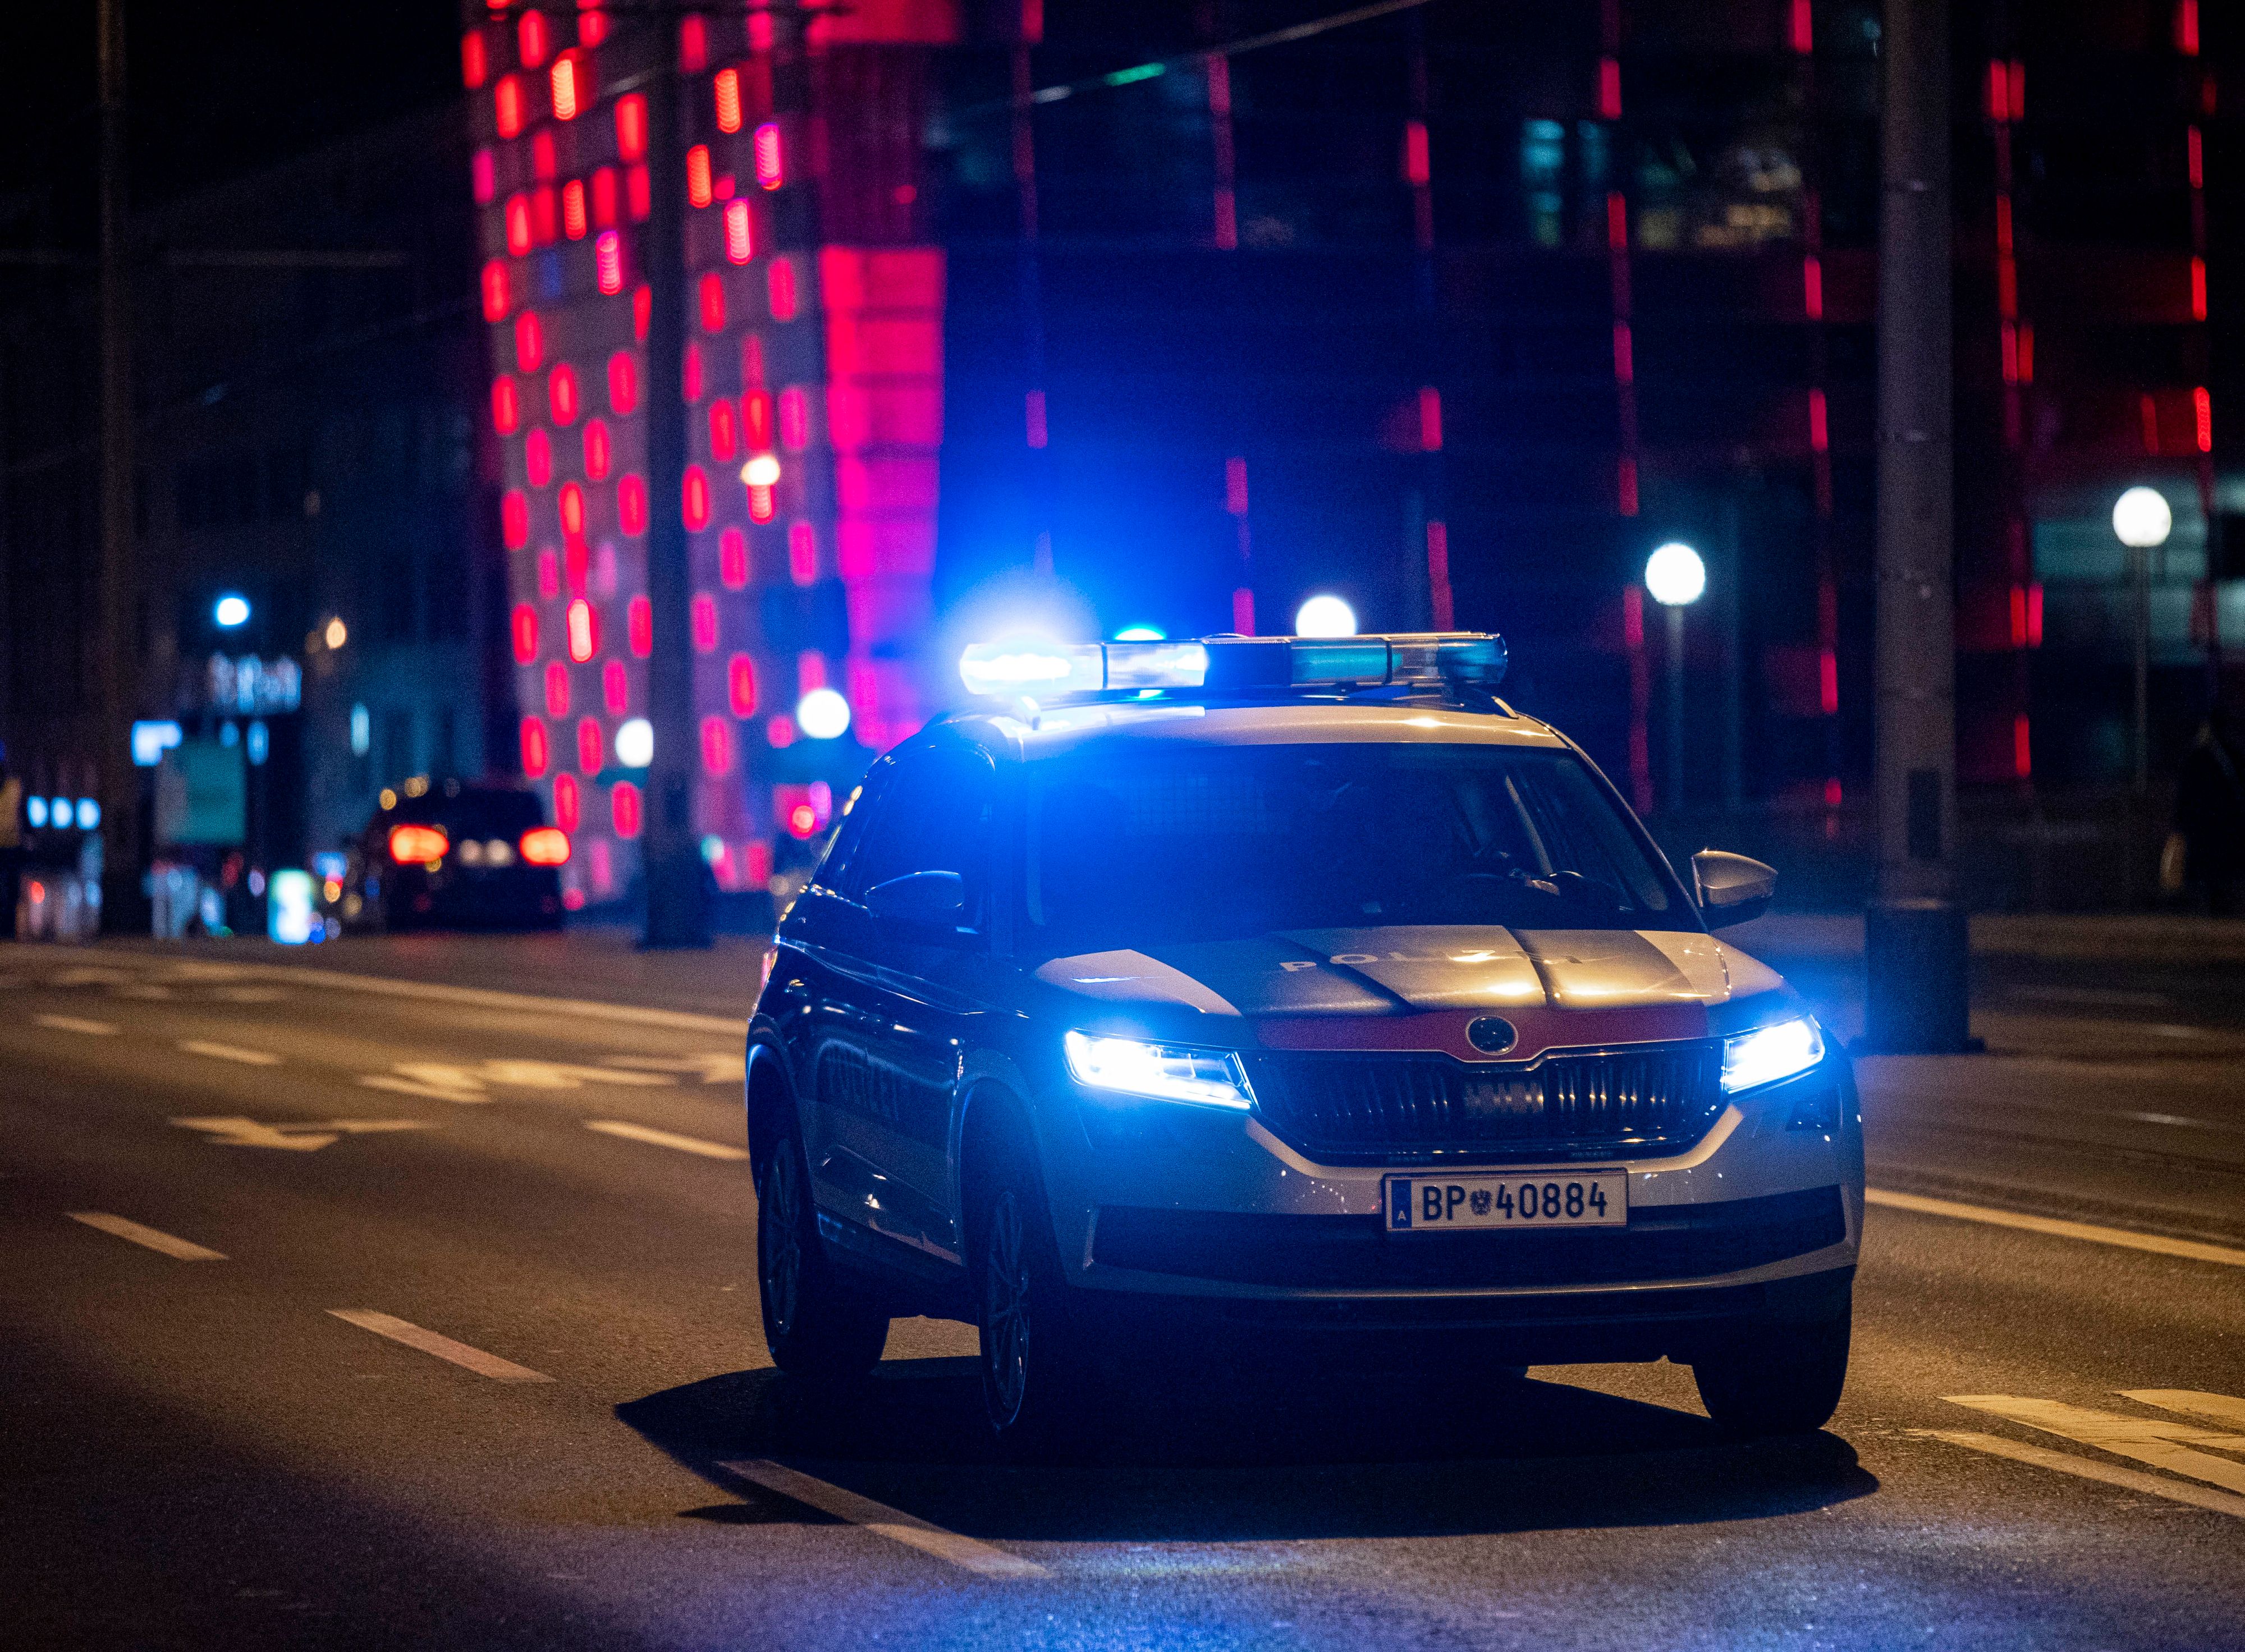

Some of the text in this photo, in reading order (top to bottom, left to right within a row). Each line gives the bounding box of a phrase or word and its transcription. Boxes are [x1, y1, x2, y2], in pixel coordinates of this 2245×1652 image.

[1423, 1181, 1607, 1221] BP 40884
[1397, 1209, 1406, 1221] A
